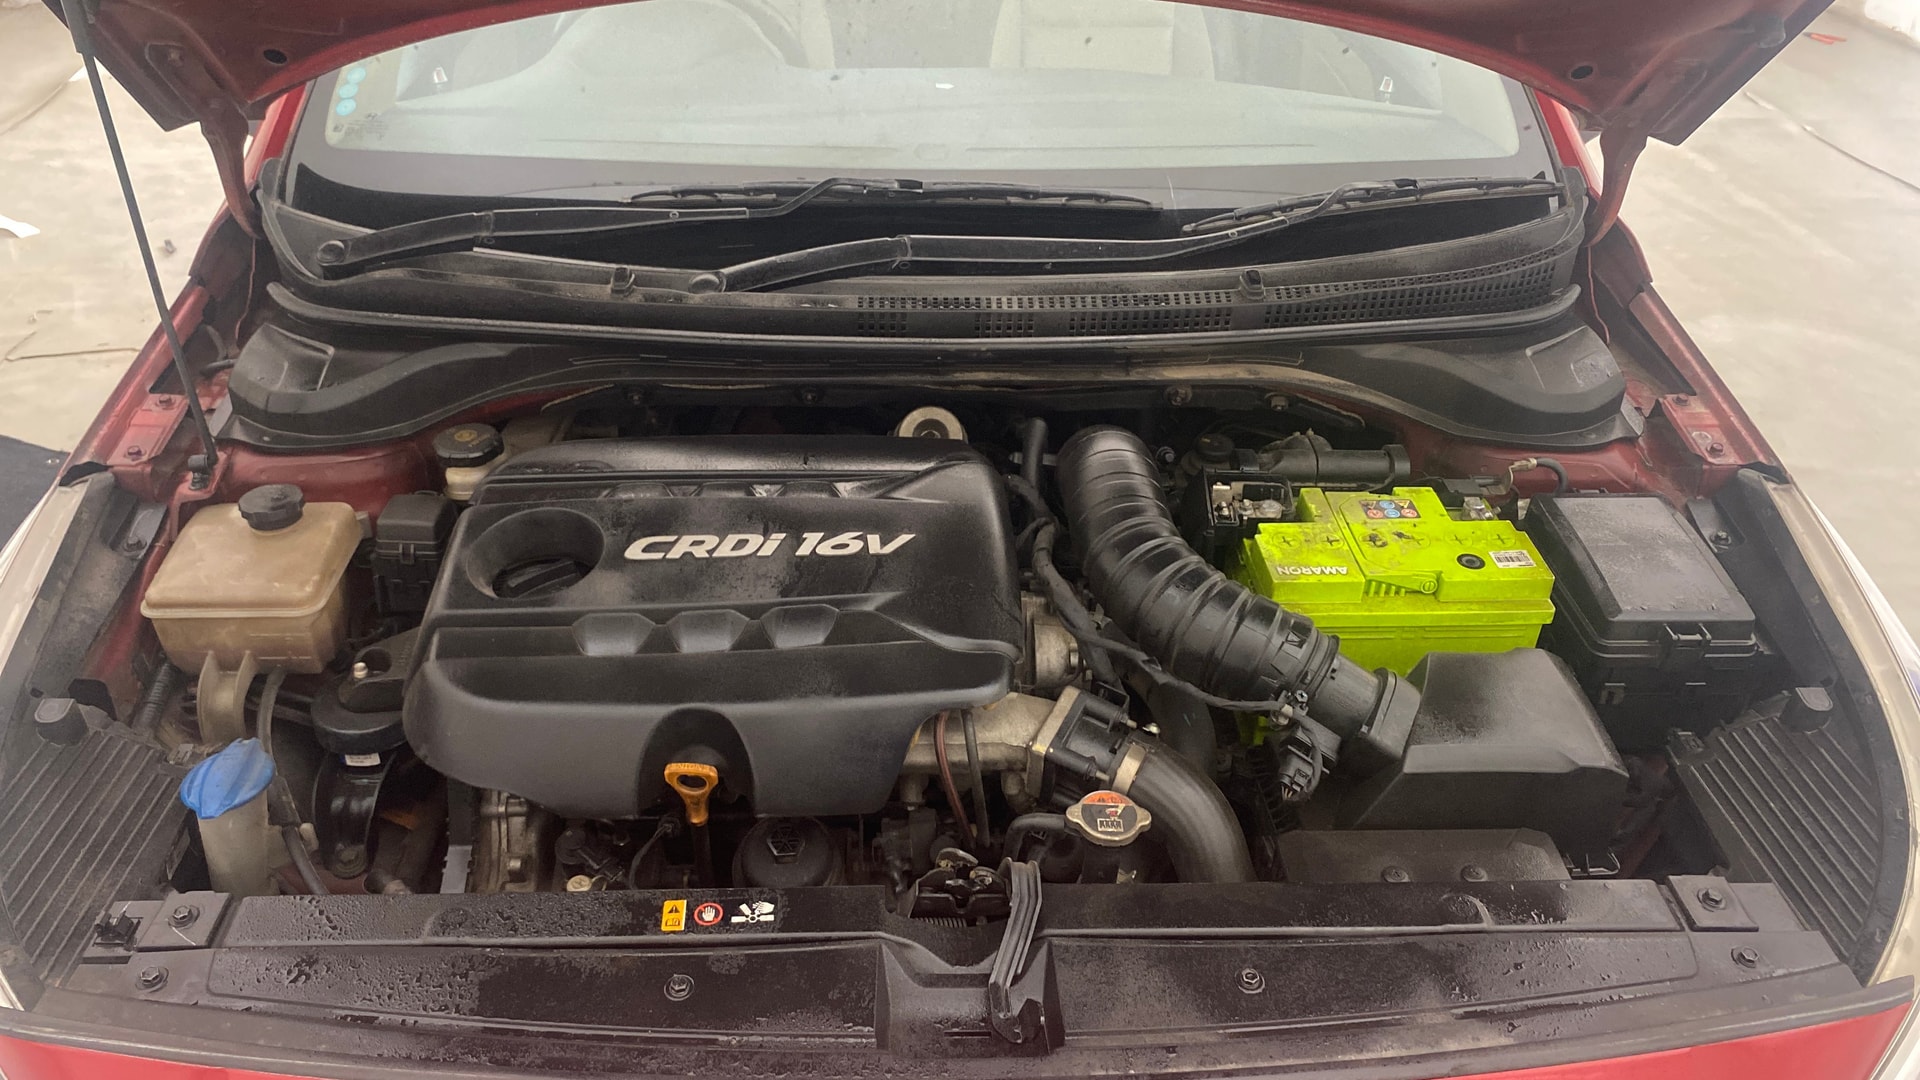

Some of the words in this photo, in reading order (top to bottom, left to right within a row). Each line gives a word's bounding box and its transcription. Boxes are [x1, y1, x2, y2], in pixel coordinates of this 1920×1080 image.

[624, 532, 787, 560] CRDi
[795, 531, 916, 557] 16V
[1275, 565, 1349, 576] AMARON
